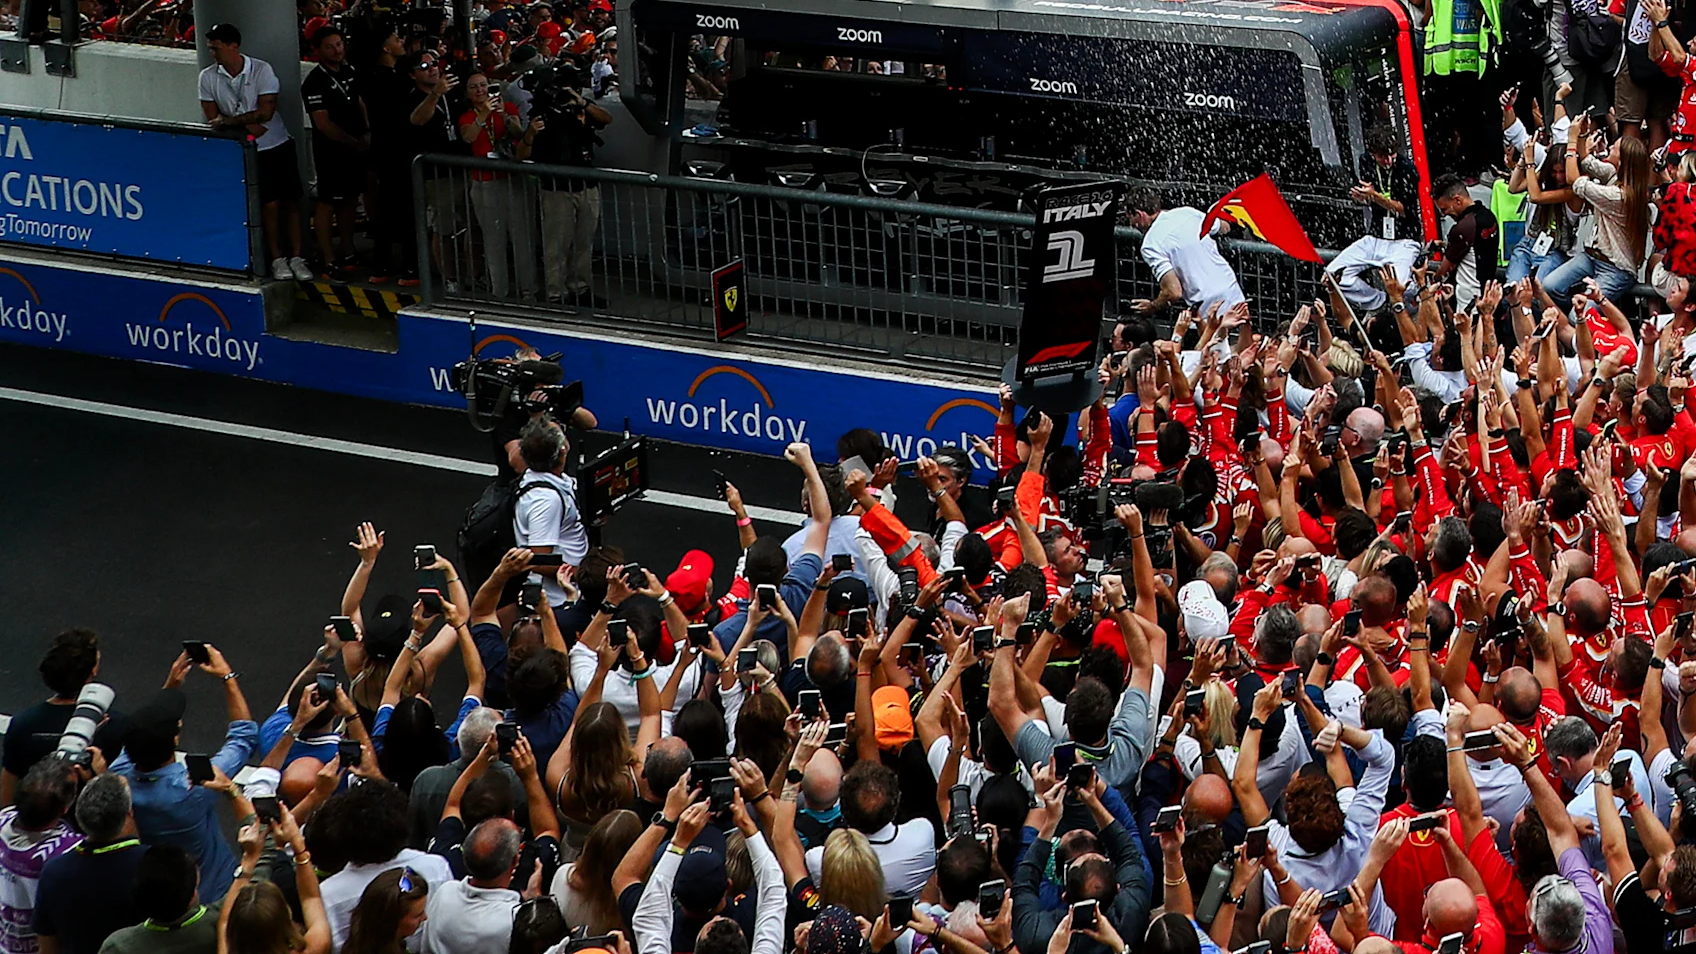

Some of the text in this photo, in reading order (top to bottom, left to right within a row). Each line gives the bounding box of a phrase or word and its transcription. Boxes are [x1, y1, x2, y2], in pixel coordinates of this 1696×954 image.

[696, 14, 740, 31] zoom
[837, 27, 883, 44] zoom
[1029, 78, 1078, 96] zoom
[1183, 91, 1235, 110] zoom
[1, 171, 145, 222] CATIONS
[1043, 200, 1112, 224] ITALY
[126, 320, 260, 371] workday
[647, 394, 807, 443] workday
[881, 432, 1001, 471] work
